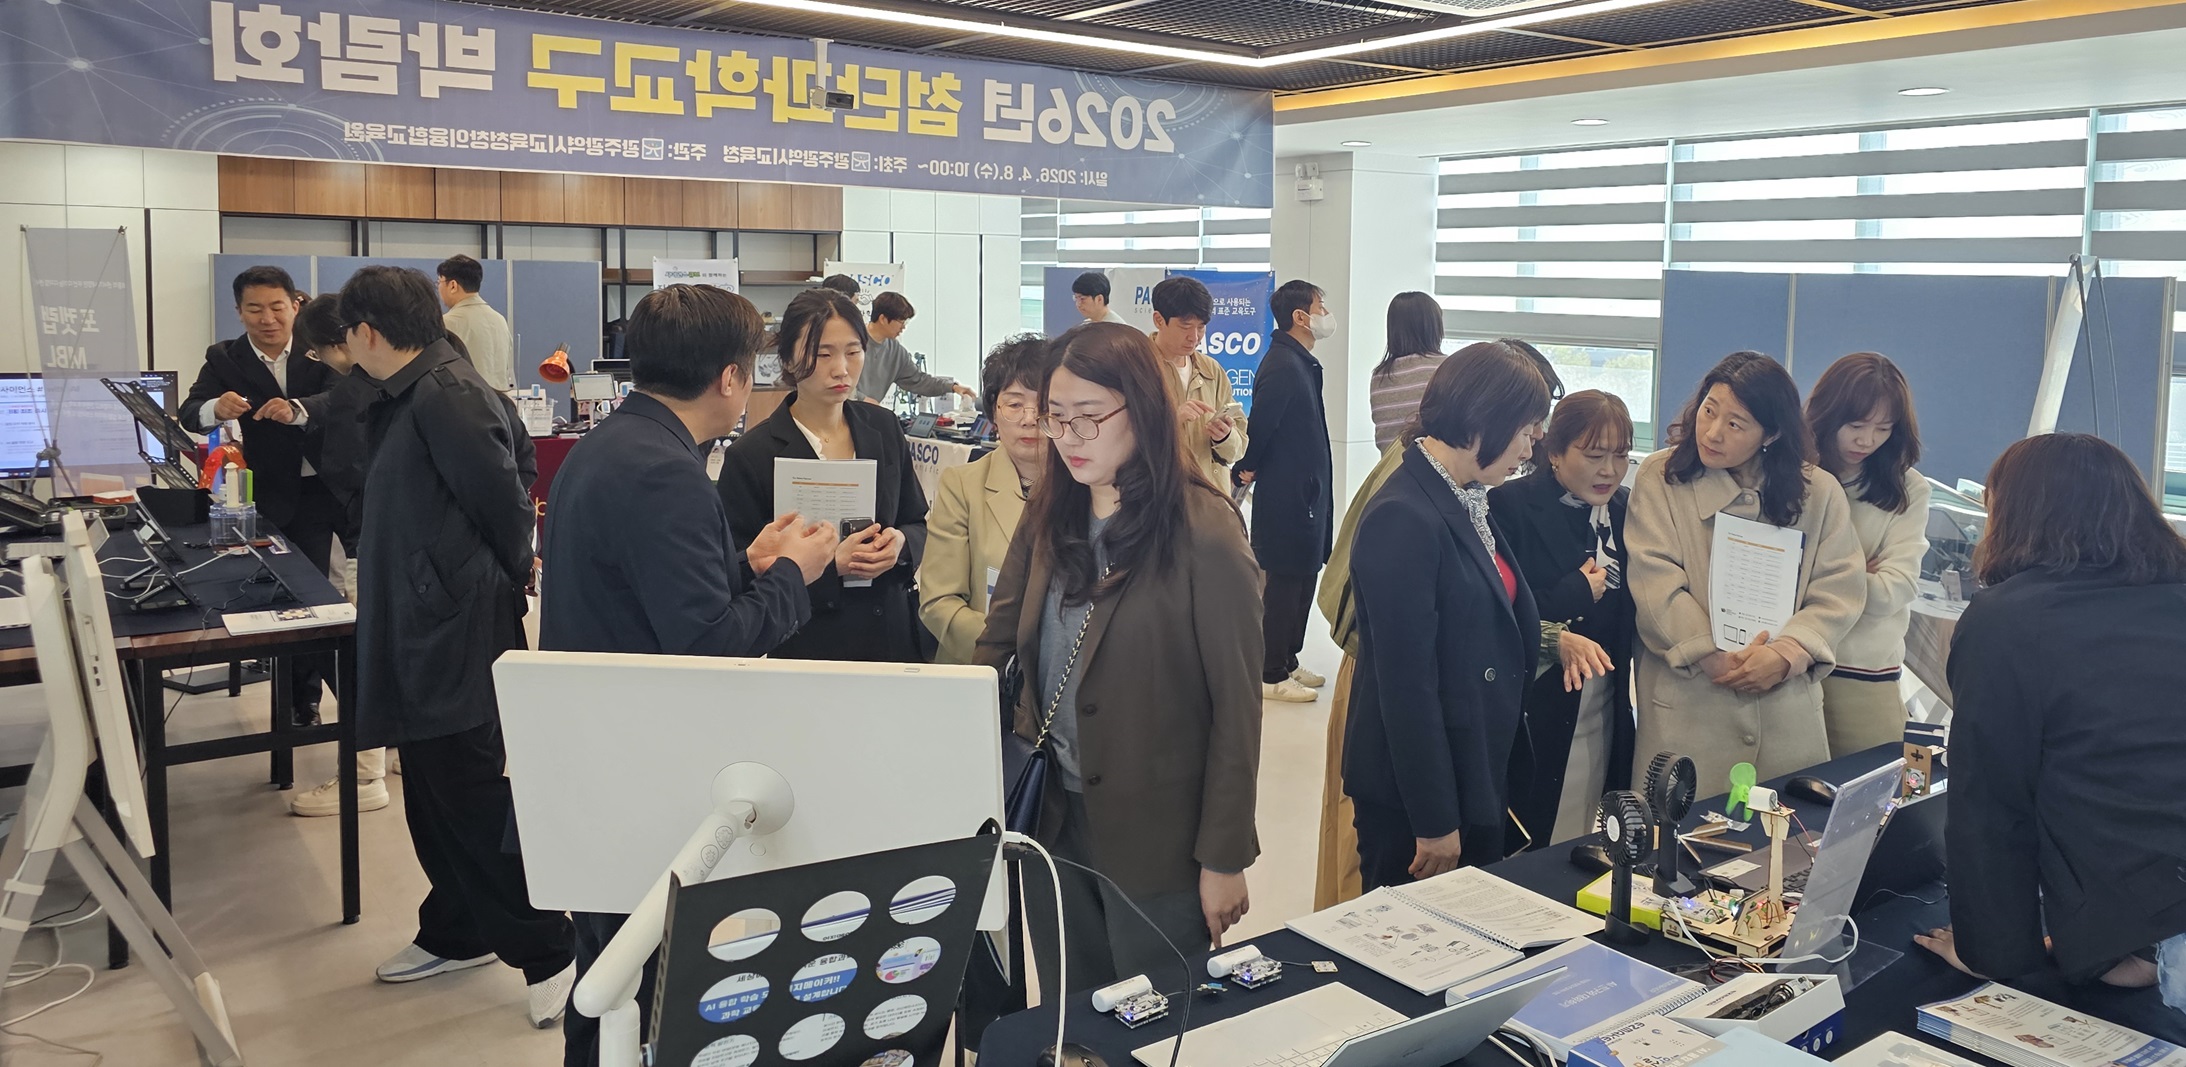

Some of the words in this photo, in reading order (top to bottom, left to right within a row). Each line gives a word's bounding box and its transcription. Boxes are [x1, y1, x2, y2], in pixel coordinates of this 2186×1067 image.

[1135, 286, 1150, 304] PA
[1227, 297, 1252, 307] 사용되는
[1134, 306, 1152, 314] scie
[1217, 306, 1231, 316] 표준
[1231, 306, 1257, 317] 교육도구
[1196, 331, 1262, 356] ASCO
[911, 441, 939, 465] ASCO
[820, 953, 854, 966] 융합과
[704, 1002, 716, 1012] AI
[1600, 1021, 1645, 1043] EZMAKE
